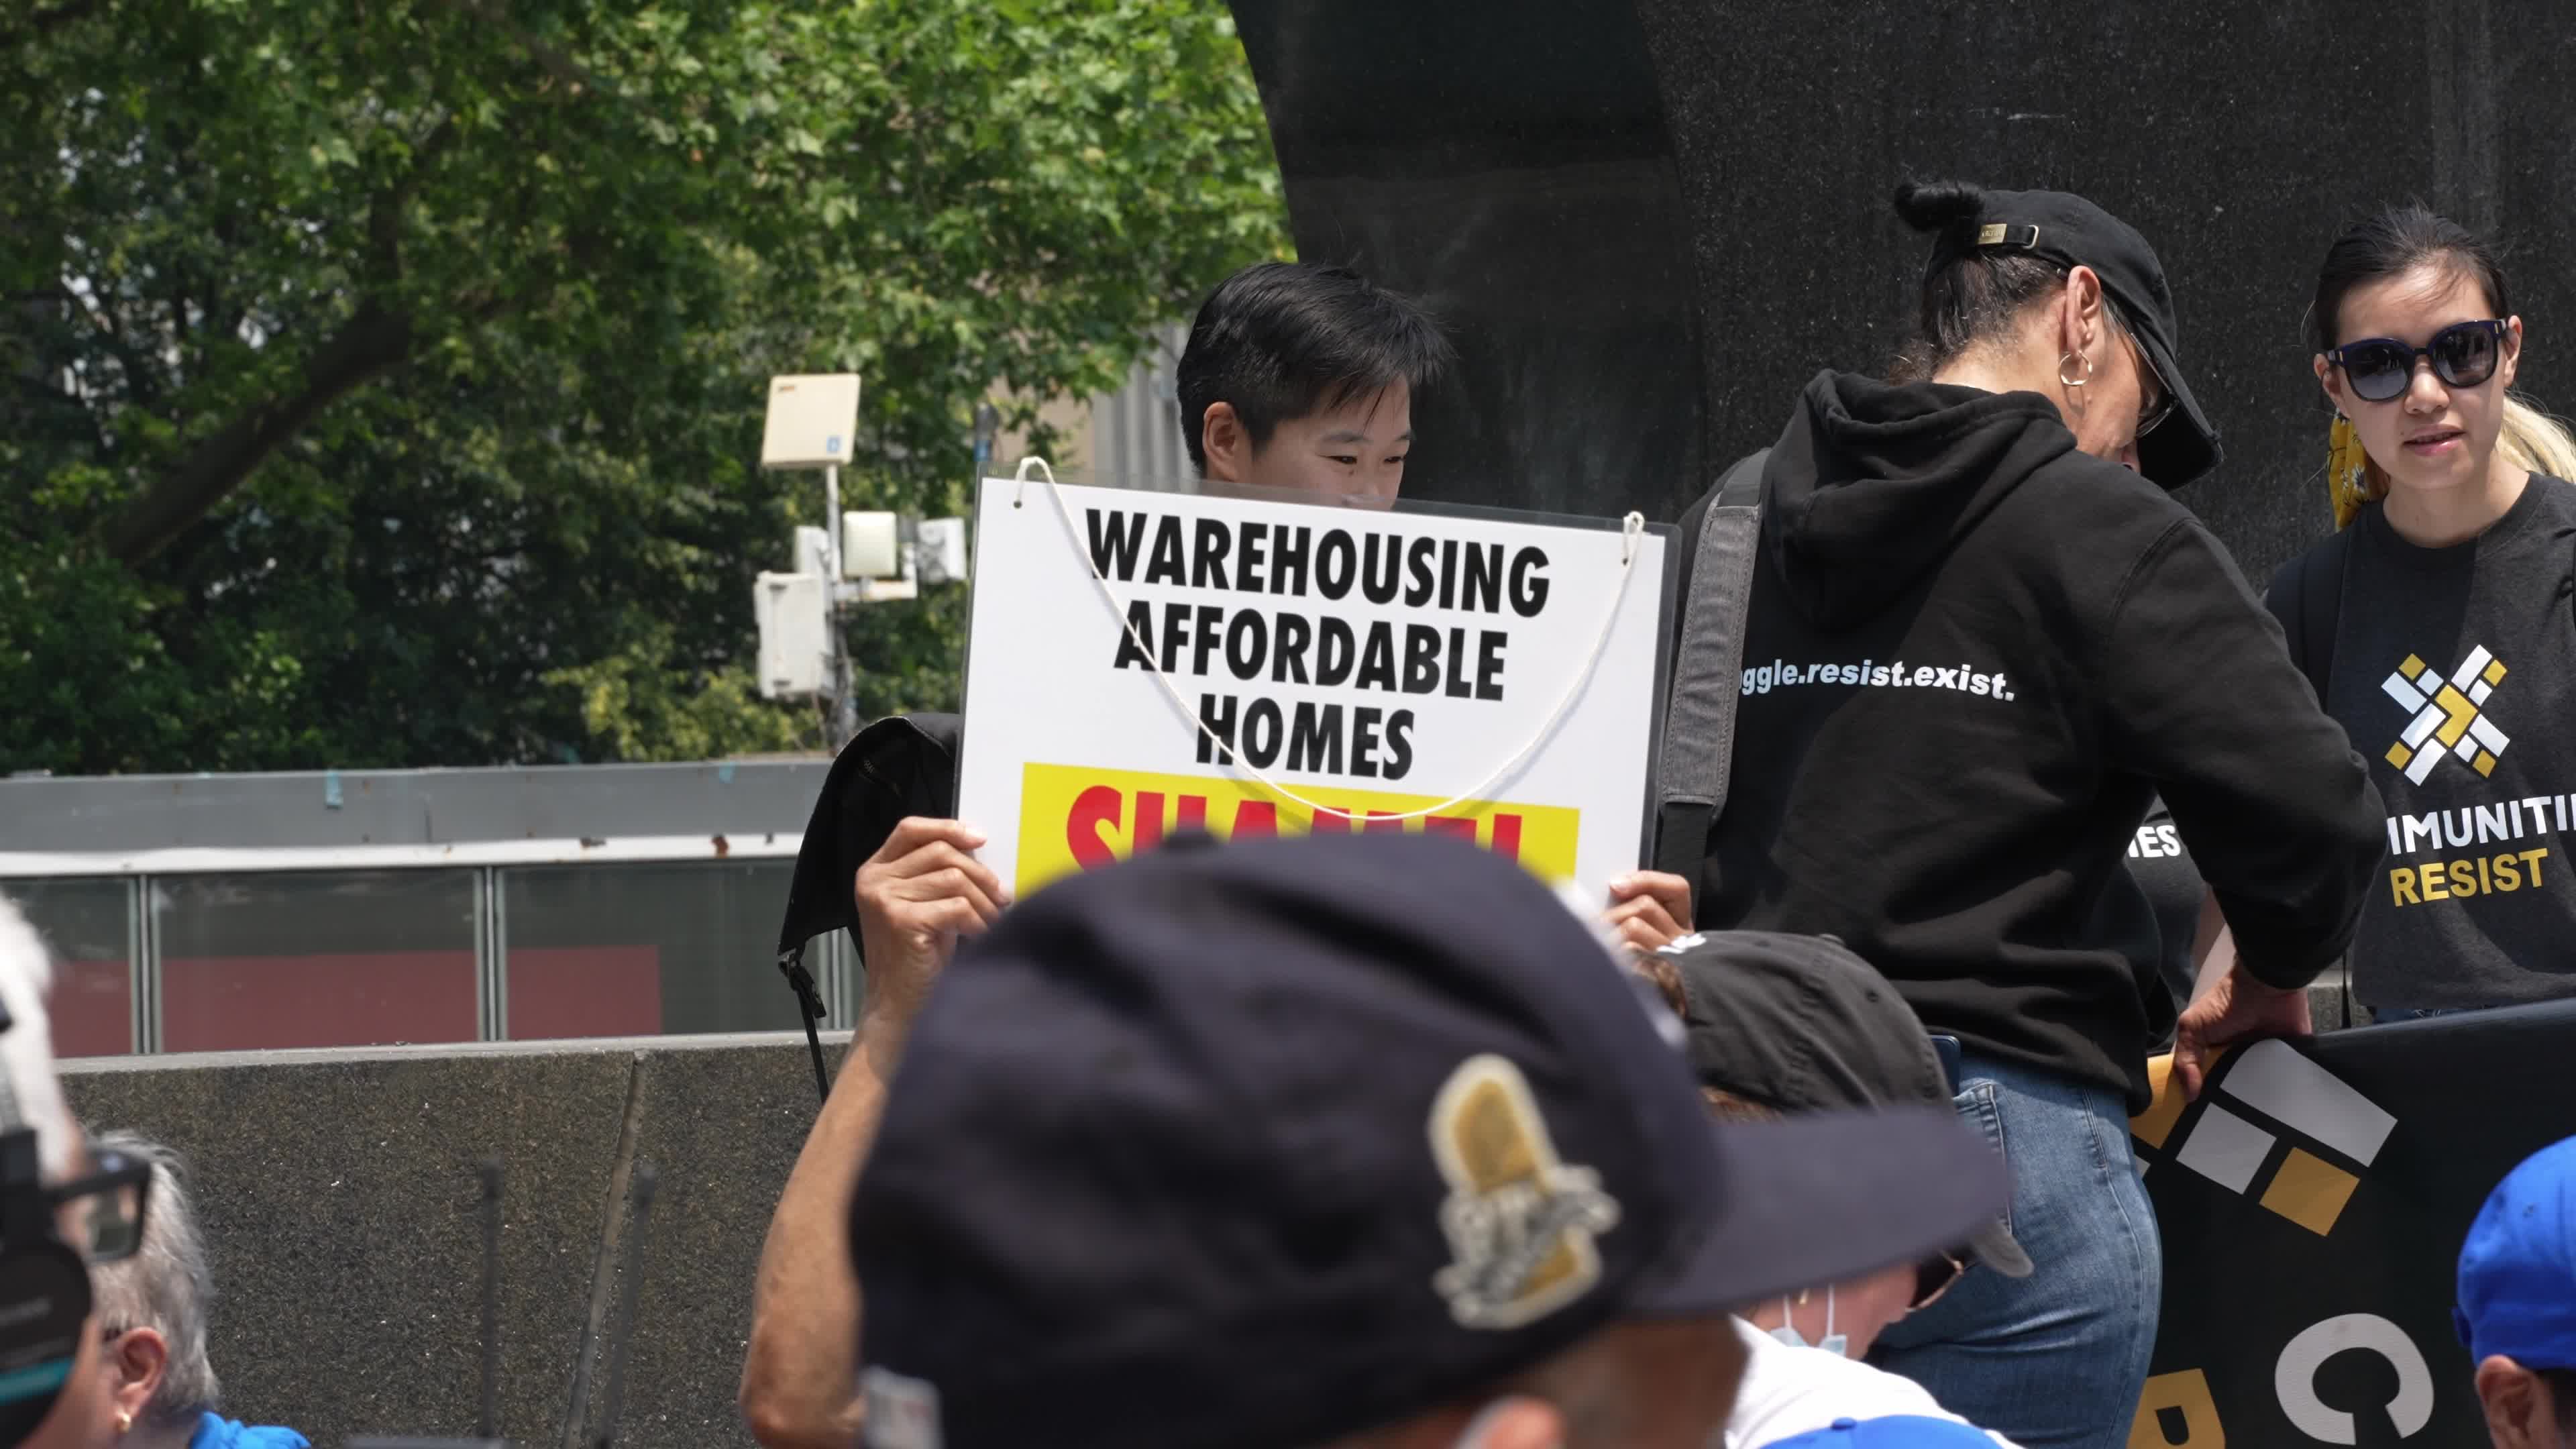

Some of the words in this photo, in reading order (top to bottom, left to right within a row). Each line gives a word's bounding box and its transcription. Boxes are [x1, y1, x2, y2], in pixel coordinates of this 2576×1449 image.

[1086, 509, 1550, 617] WAREHOUSING
[1114, 600, 1507, 700] AFFORDABLE
[1739, 659, 2015, 702] ggle.resist.exist.
[1196, 694, 1413, 780] HOMES
[2386, 793, 2576, 855] MUNITI
[2390, 847, 2548, 907] RESIST
